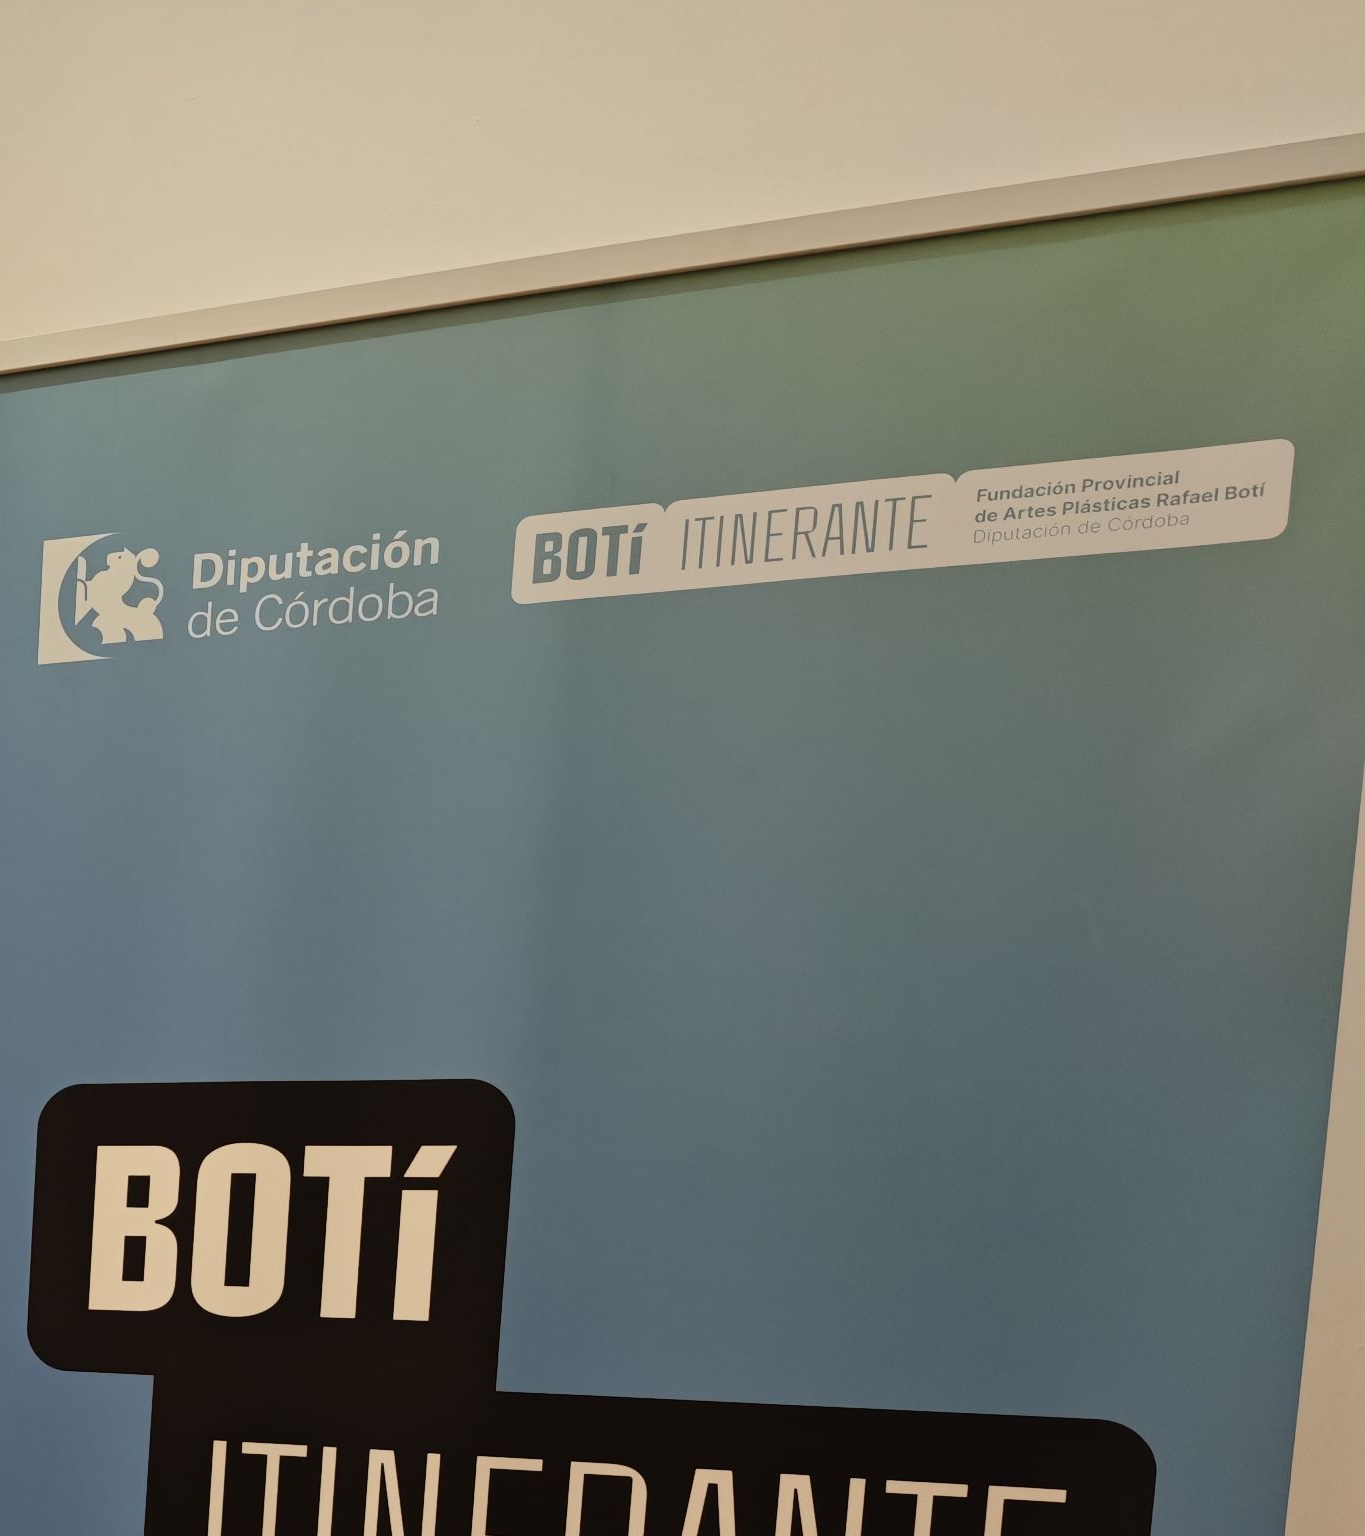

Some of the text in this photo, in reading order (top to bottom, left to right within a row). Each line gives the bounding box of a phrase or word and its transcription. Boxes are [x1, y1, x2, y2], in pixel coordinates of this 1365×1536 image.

[974, 481, 1267, 524] de Artes Plásticas Rafael Botí
[976, 470, 1180, 503] Fundación Provincial
[681, 494, 933, 571] ITINERANTE
[973, 511, 1190, 545] Diputación de Córdoba
[192, 529, 441, 594] Diputación
[187, 582, 439, 639] de Córdoba
